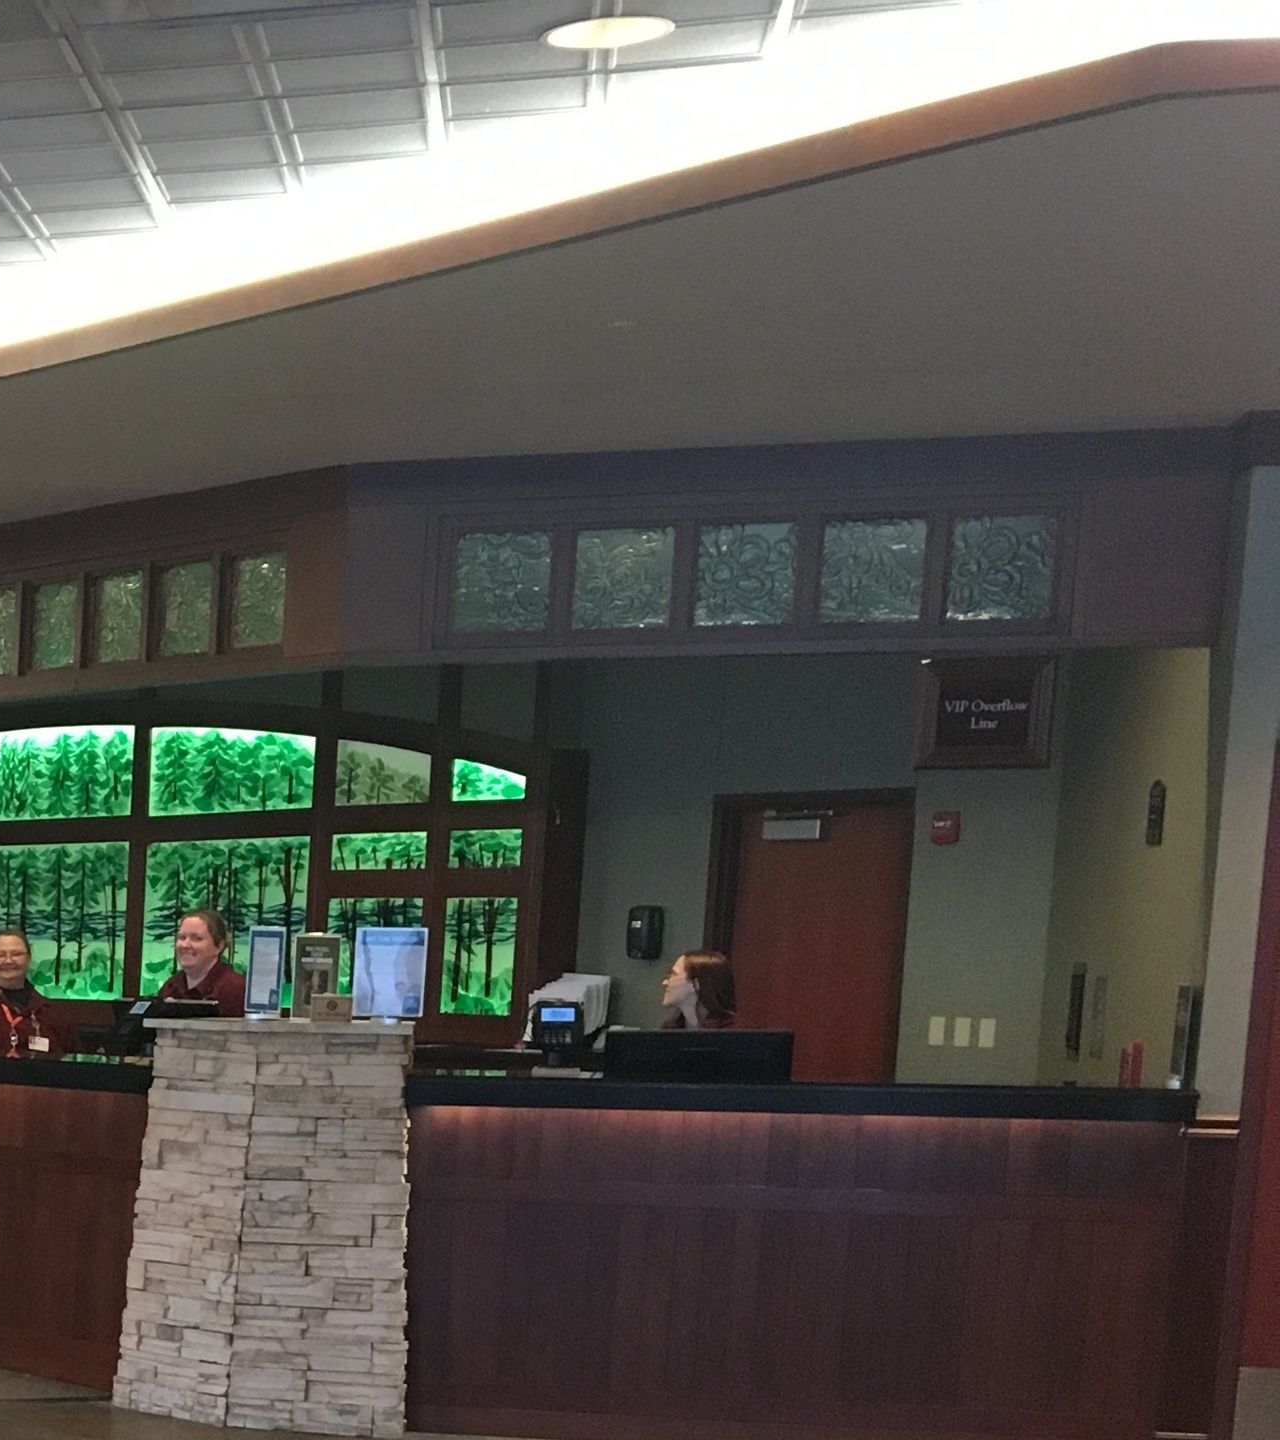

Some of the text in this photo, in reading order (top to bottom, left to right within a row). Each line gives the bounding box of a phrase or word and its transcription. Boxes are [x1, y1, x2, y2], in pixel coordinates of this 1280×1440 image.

[944, 698, 1028, 713] VIP Overflow
[970, 716, 999, 729] Line
